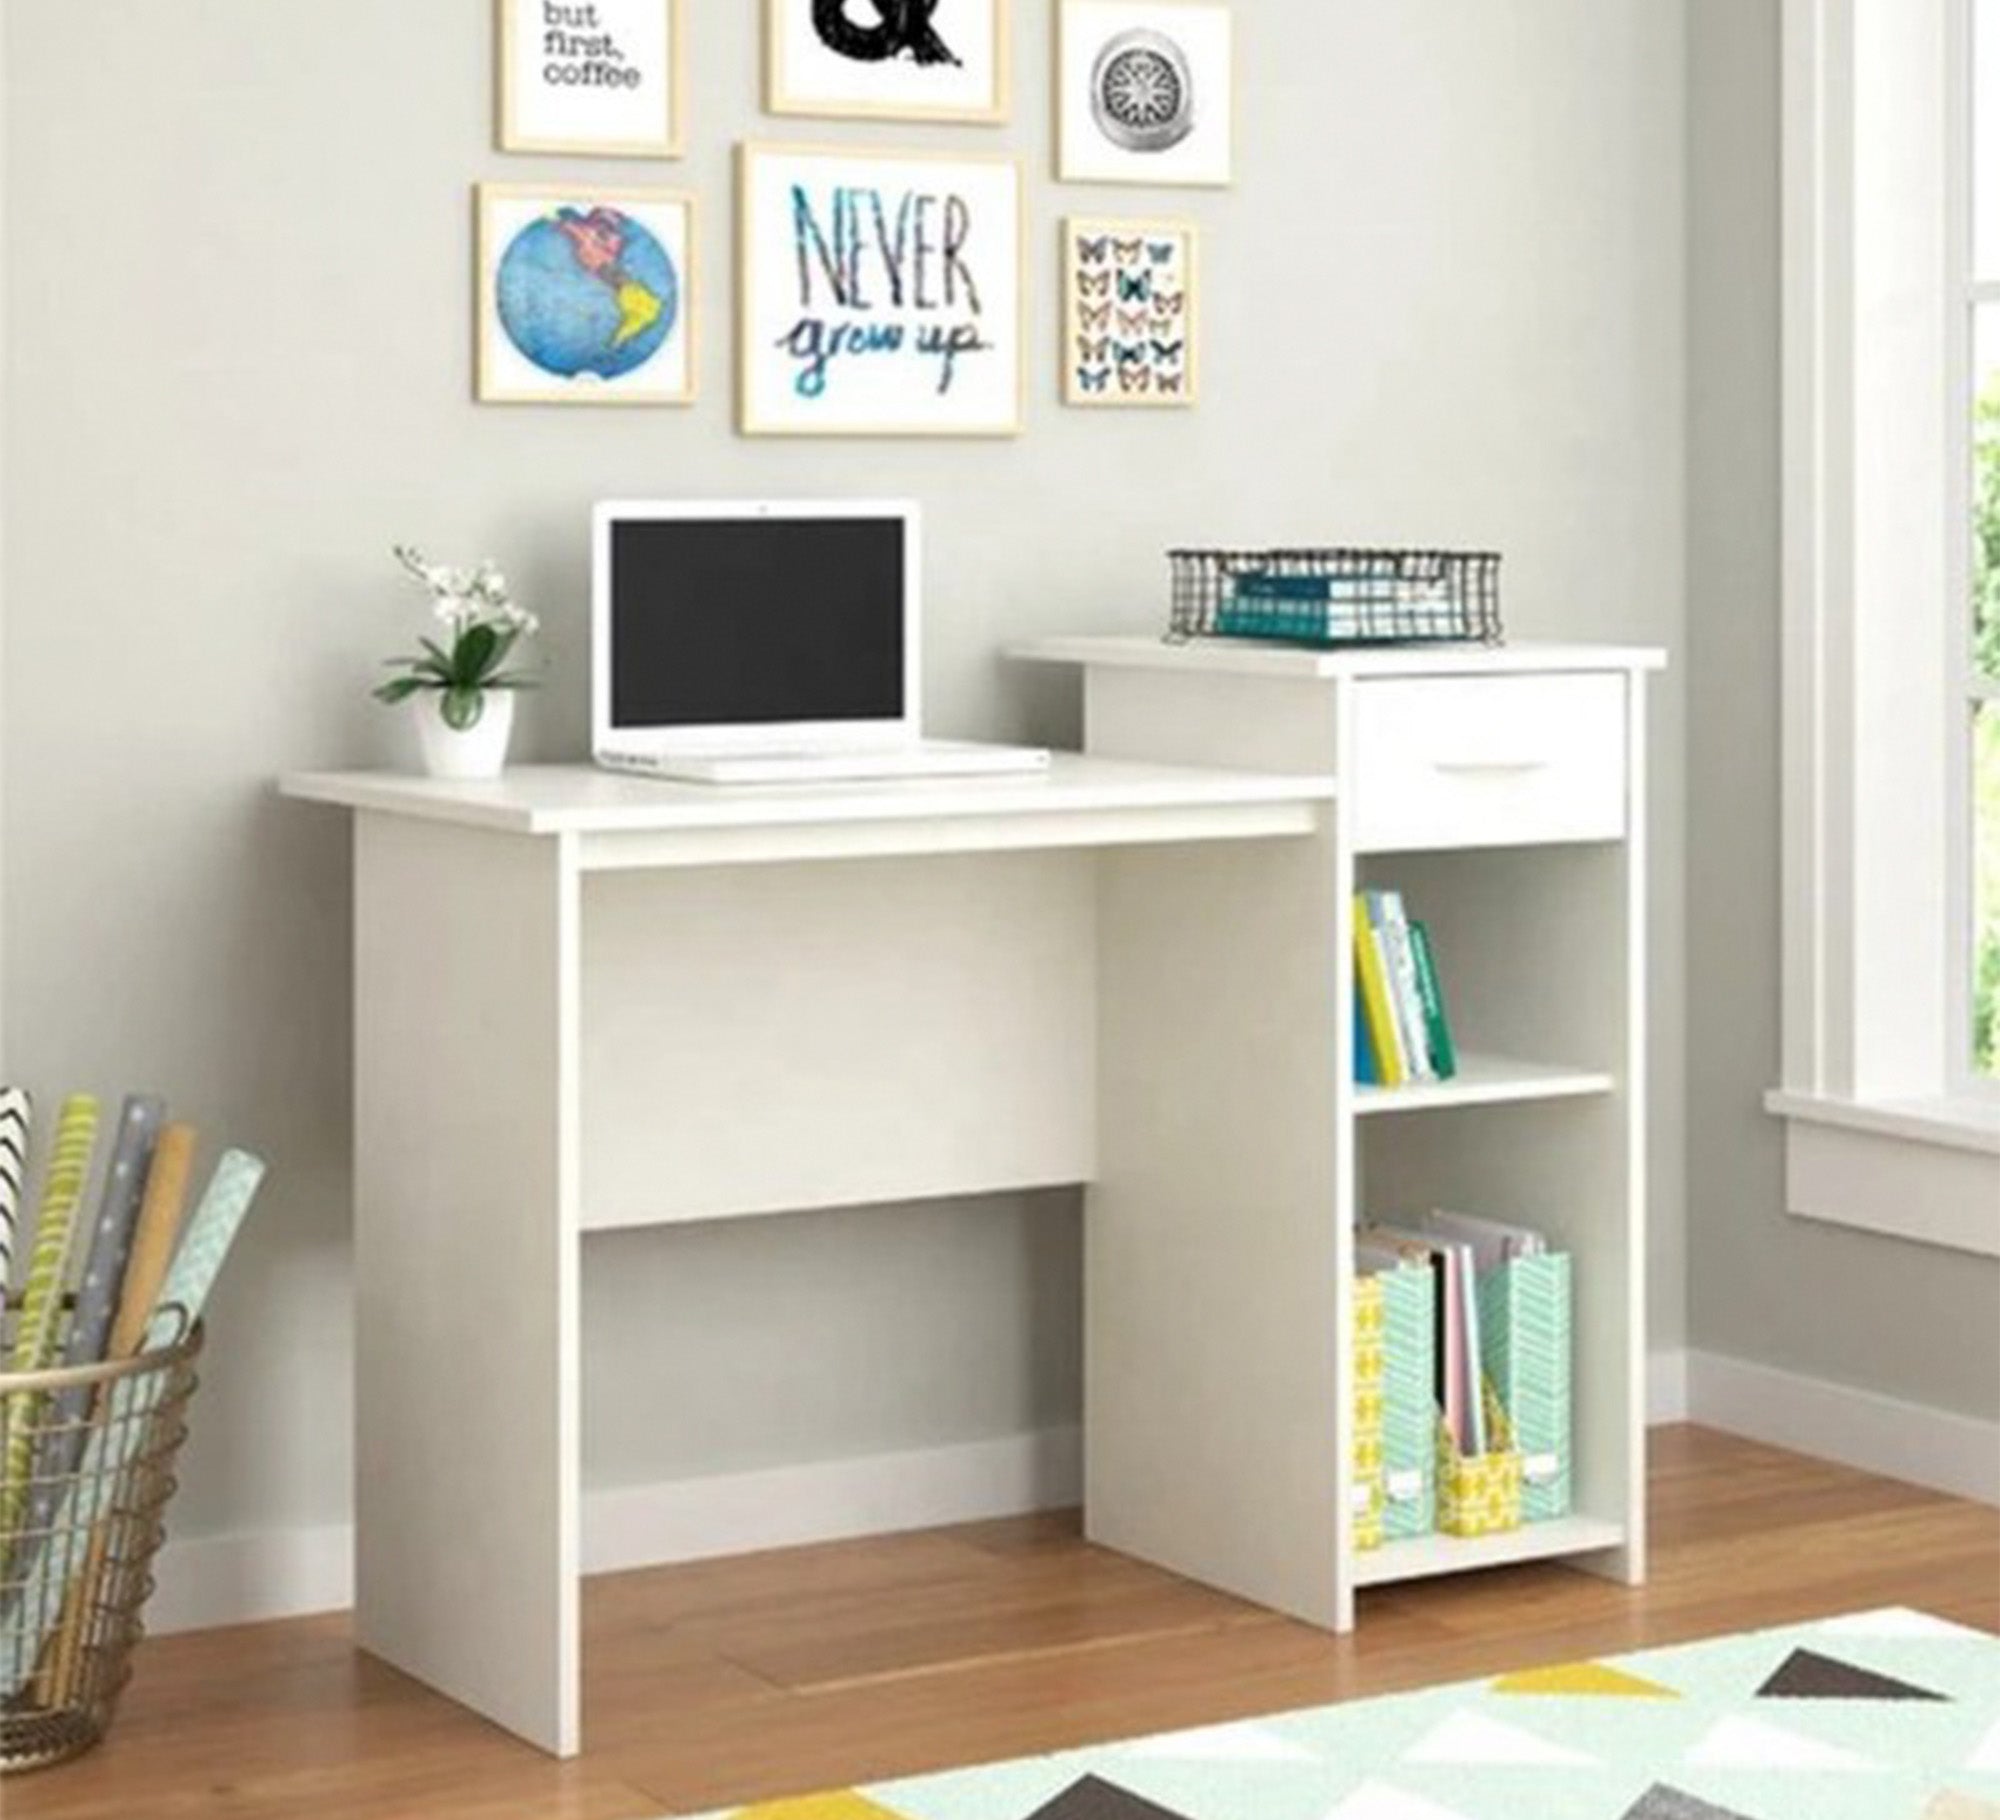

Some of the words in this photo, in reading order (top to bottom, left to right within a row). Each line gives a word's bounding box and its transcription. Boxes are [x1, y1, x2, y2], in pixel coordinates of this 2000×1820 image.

[543, 0, 599, 28] but
[543, 61, 641, 89] coffee
[791, 184, 981, 316] NEVER
[774, 317, 904, 398] grow
[914, 322, 995, 394] up
